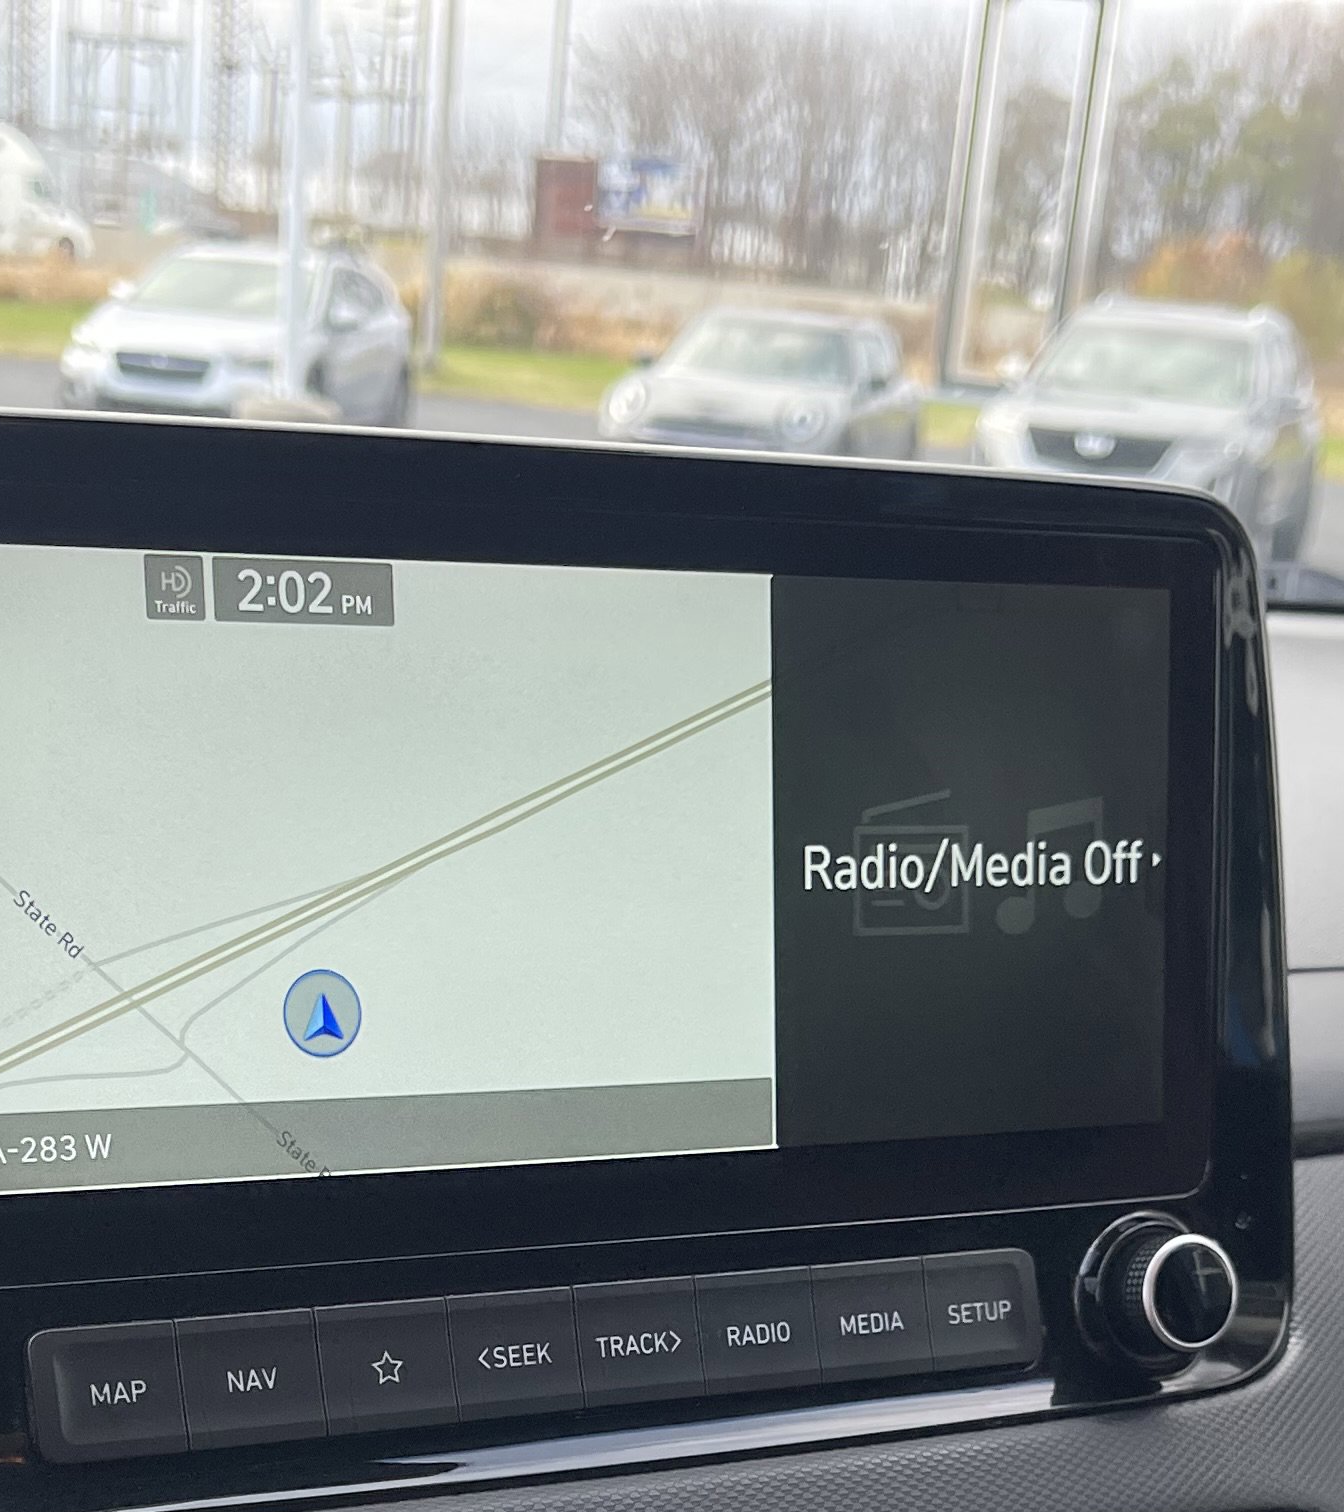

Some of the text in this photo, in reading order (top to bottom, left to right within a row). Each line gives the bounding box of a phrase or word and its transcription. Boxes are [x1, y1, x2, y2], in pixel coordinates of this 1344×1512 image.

[237, 567, 372, 616] 2:02 PM
[154, 600, 197, 614] Traffic
[803, 838, 1143, 893] Radio/Media Off
[13, 890, 84, 958] State Rd
[84, 1133, 113, 1160] W
[276, 1130, 316, 1173] State
[839, 1311, 904, 1336] MEDIA
[947, 1301, 1012, 1326] SETUP
[727, 1321, 791, 1348] RADIO
[90, 1380, 147, 1406] MAP
[227, 1367, 278, 1393] NAV
